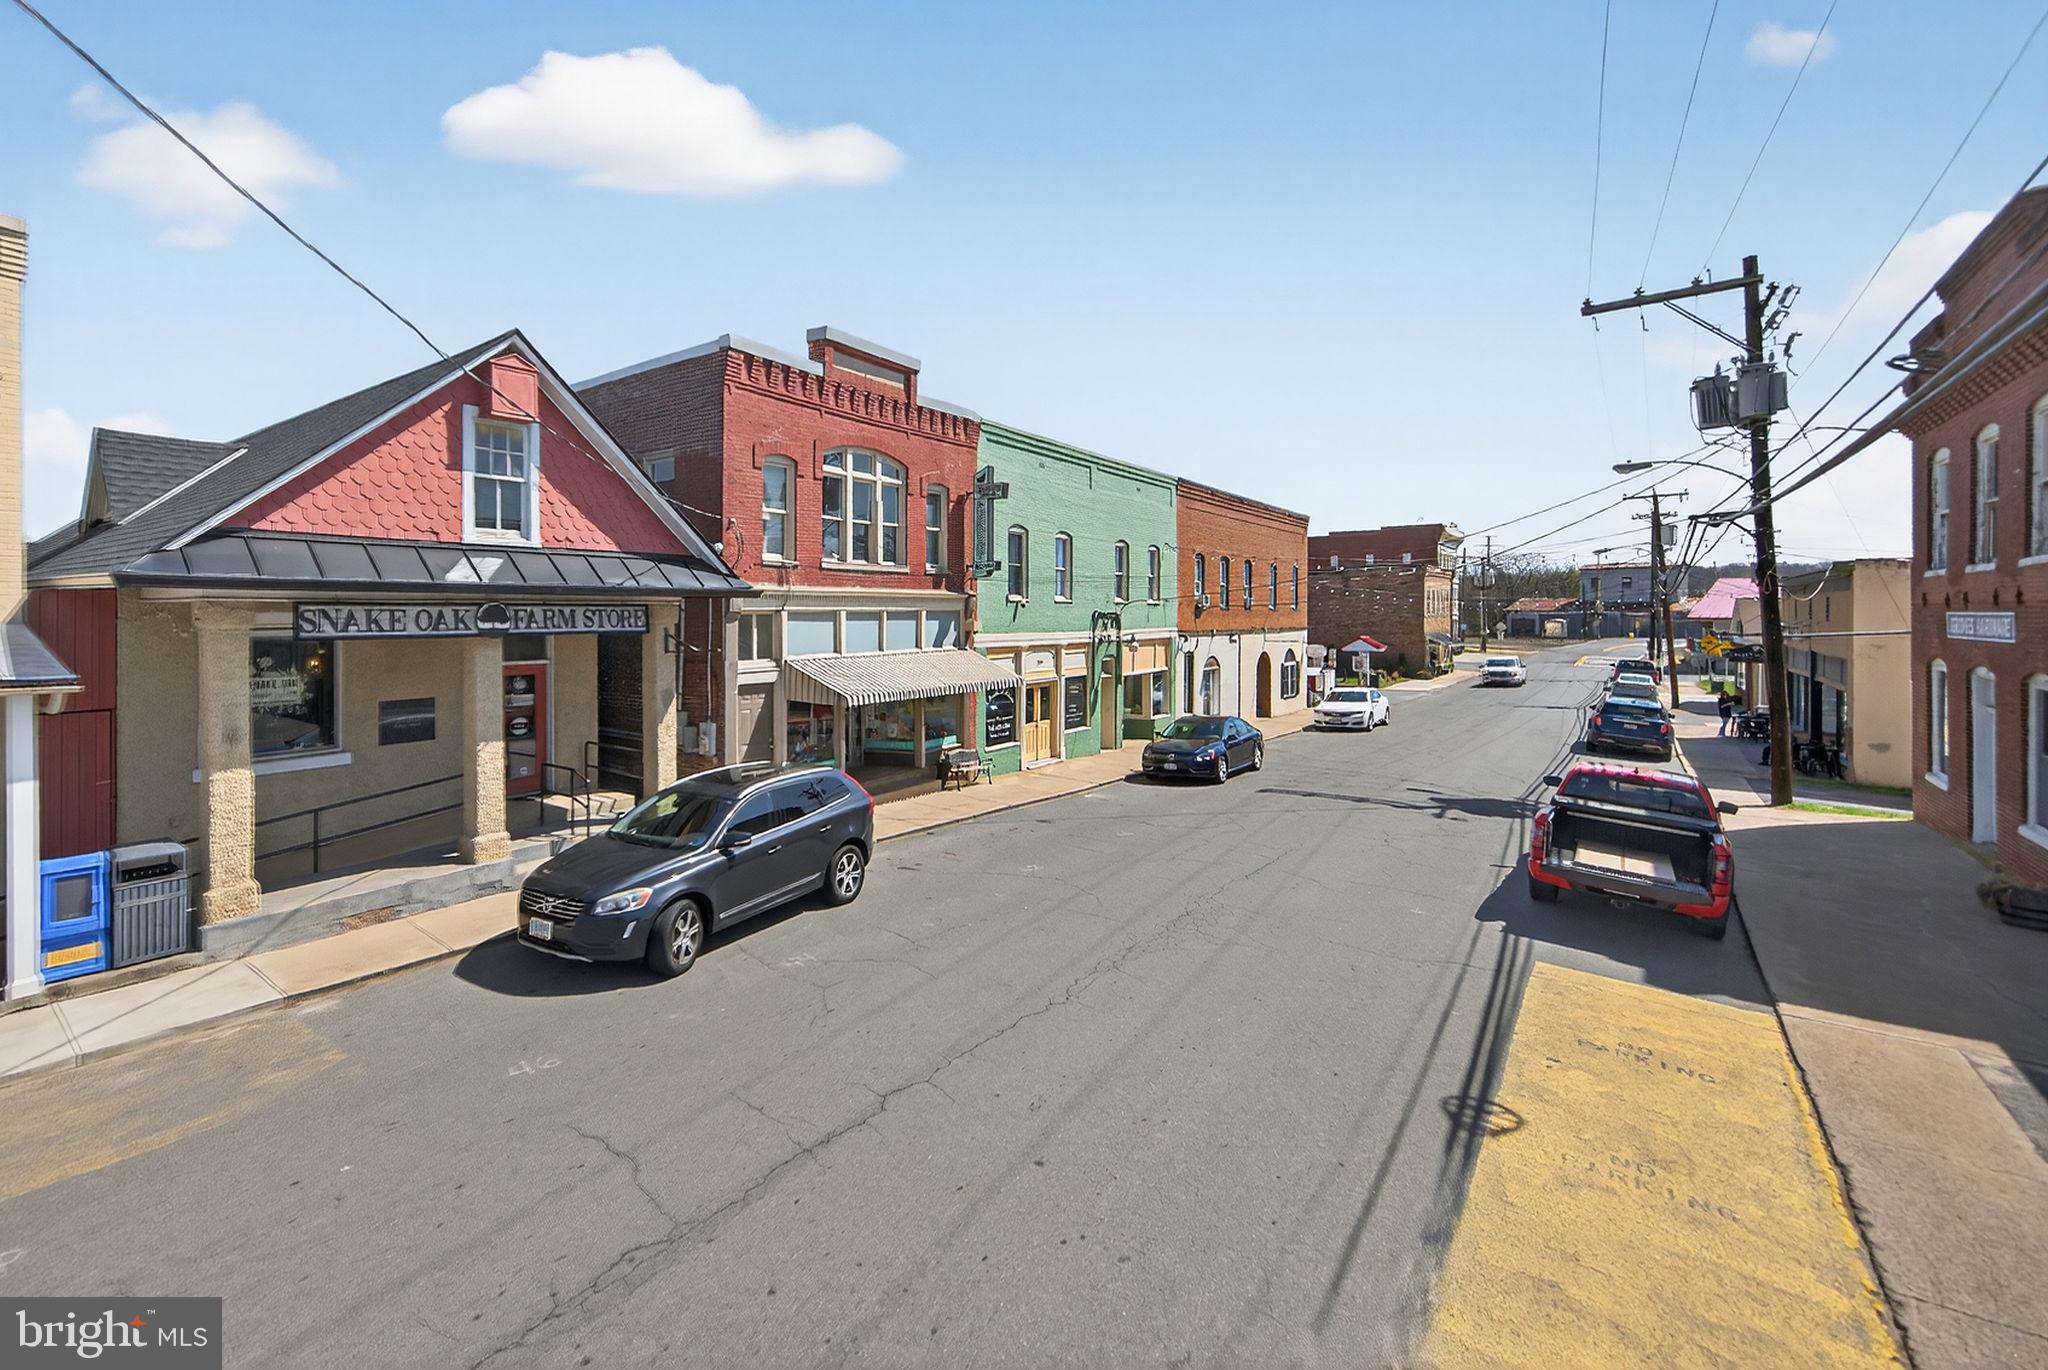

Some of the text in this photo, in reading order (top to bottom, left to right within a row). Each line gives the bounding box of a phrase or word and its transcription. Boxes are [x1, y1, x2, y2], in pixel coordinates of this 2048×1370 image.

[299, 606, 647, 633] SNAKE OAK FARM STORE
